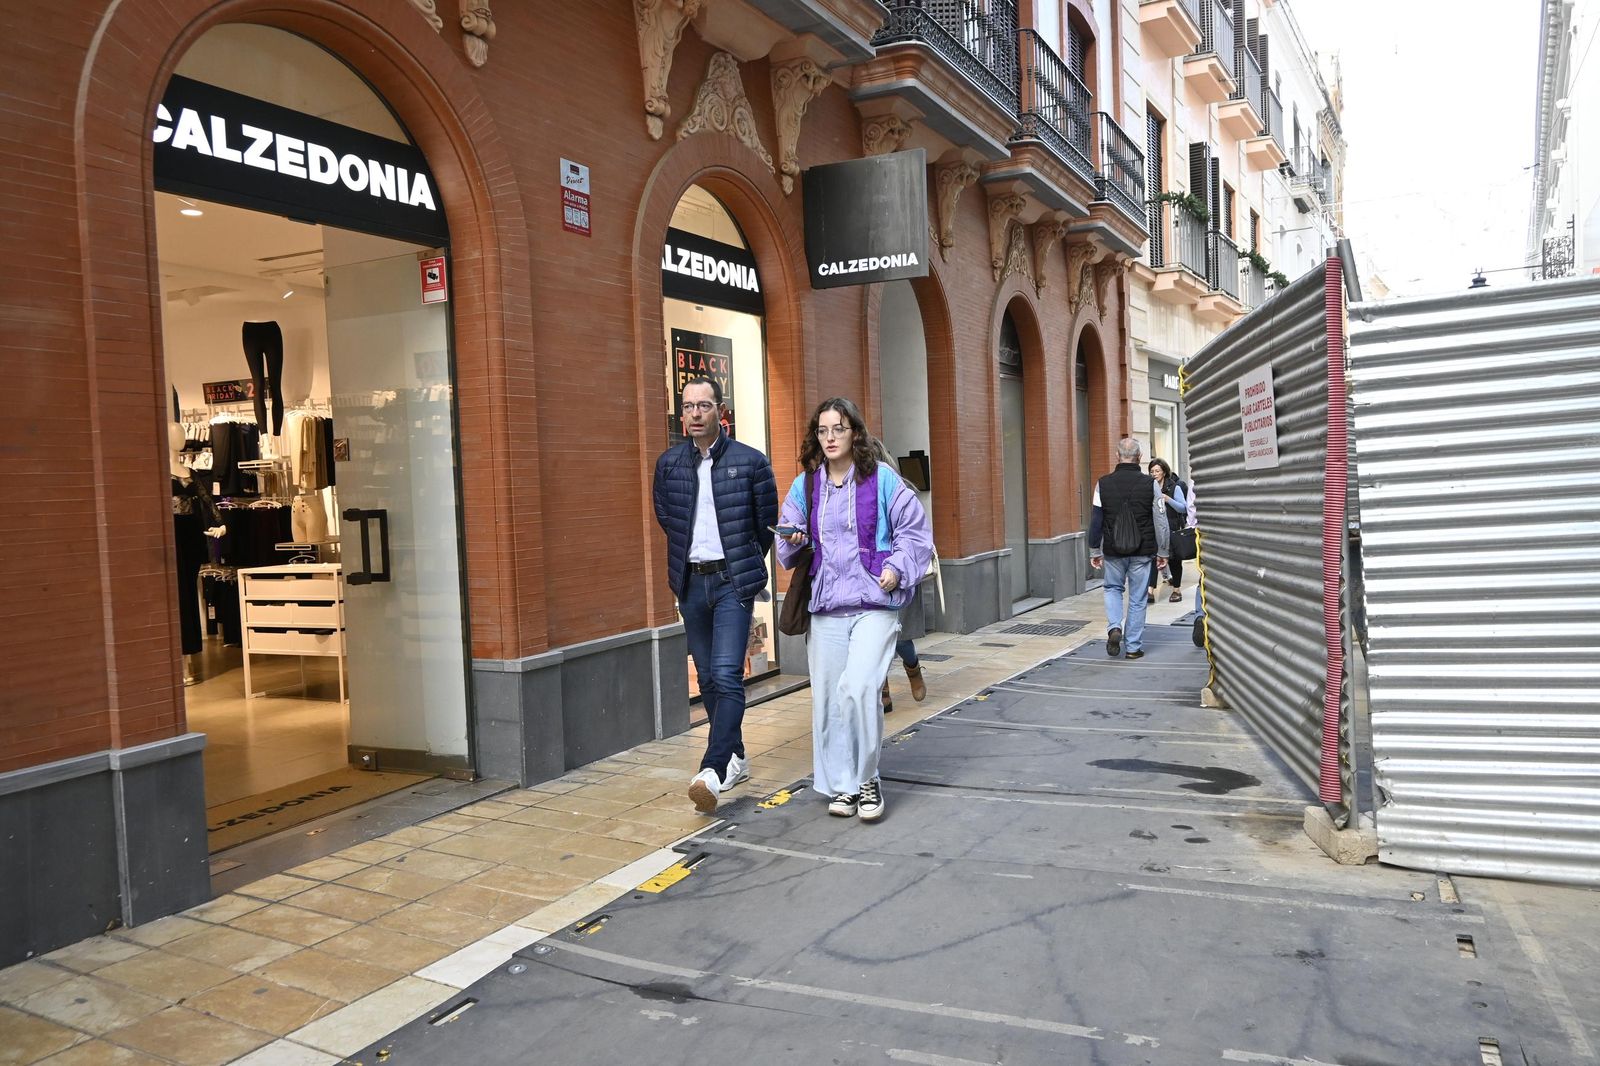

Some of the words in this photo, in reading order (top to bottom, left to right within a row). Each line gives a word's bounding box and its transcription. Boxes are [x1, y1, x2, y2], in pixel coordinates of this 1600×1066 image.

[563, 190, 588, 206] Alarma
[661, 244, 760, 293] LZEDONIA
[818, 252, 919, 276] CALZEDONIA
[678, 352, 728, 374] BLACK
[1245, 381, 1265, 398] PROHIBIDO
[1252, 396, 1273, 413] CARTELES
[1244, 415, 1273, 433] PUBLICITARIOS
